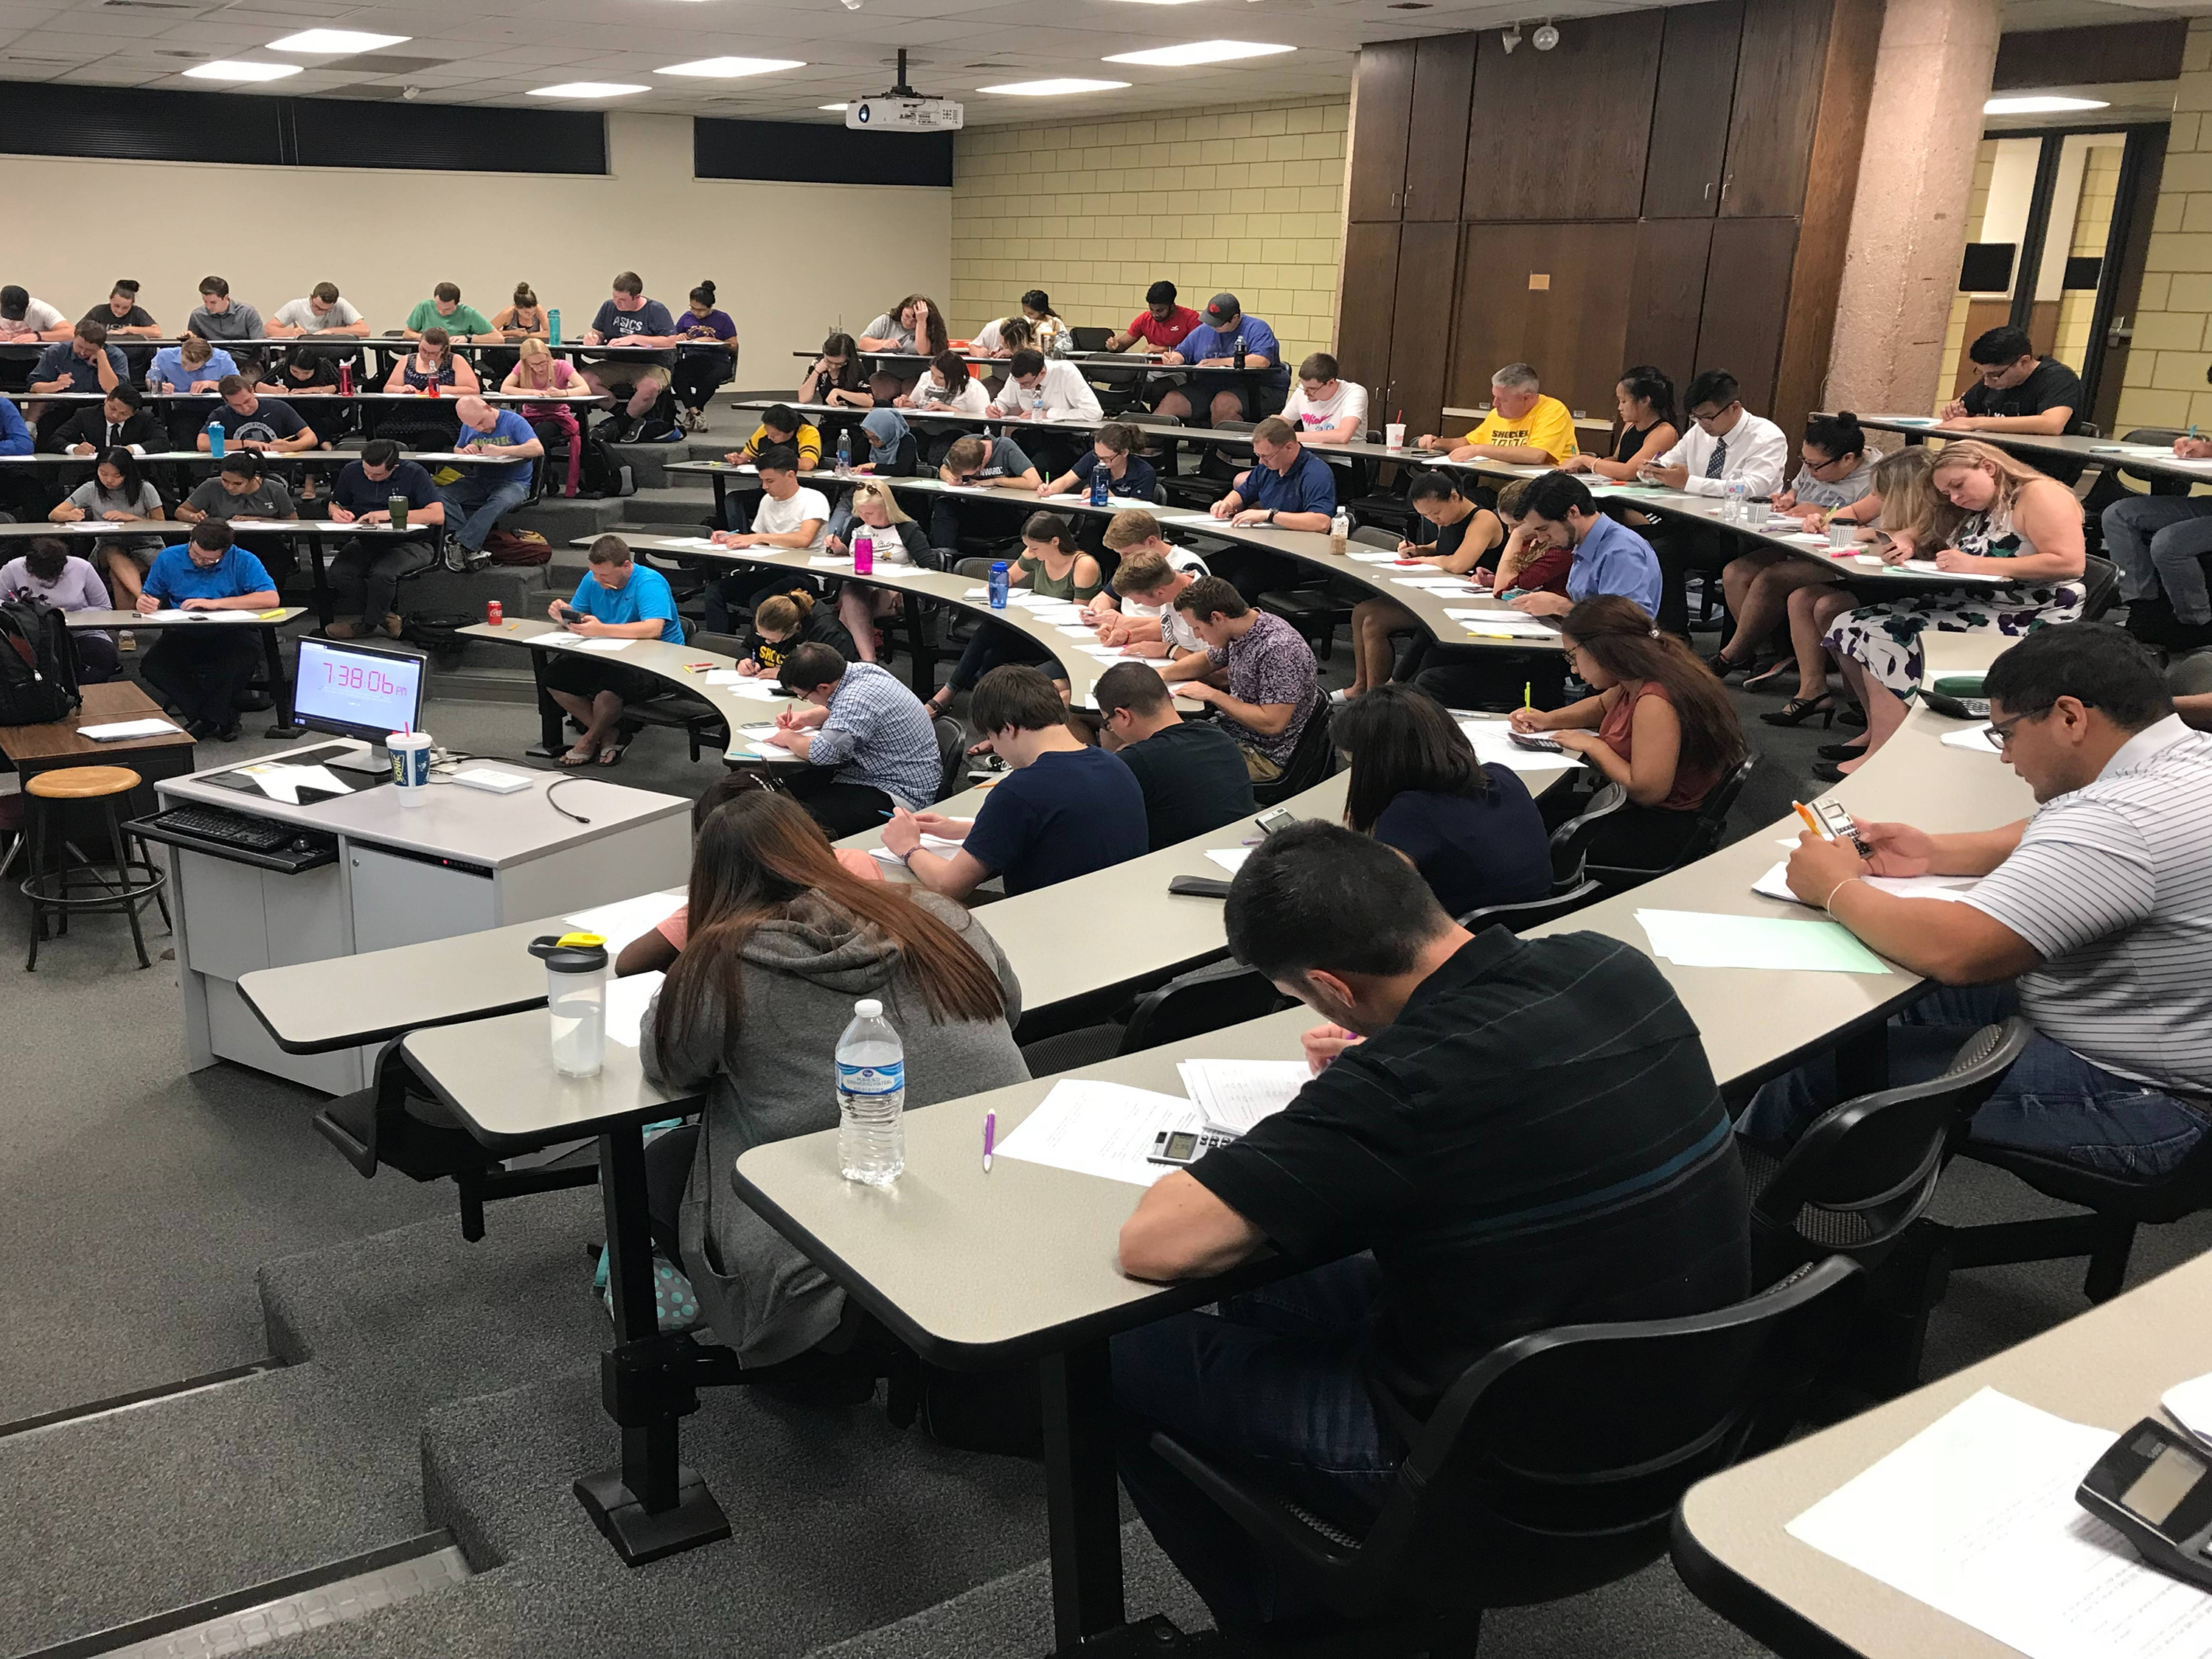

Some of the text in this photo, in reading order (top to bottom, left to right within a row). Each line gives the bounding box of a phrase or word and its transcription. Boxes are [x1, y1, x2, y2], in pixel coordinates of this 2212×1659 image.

[613, 316, 643, 331] ASICS
[322, 662, 394, 695] 7:38:06
[395, 686, 408, 697] PM
[394, 754, 404, 782] SONIC
